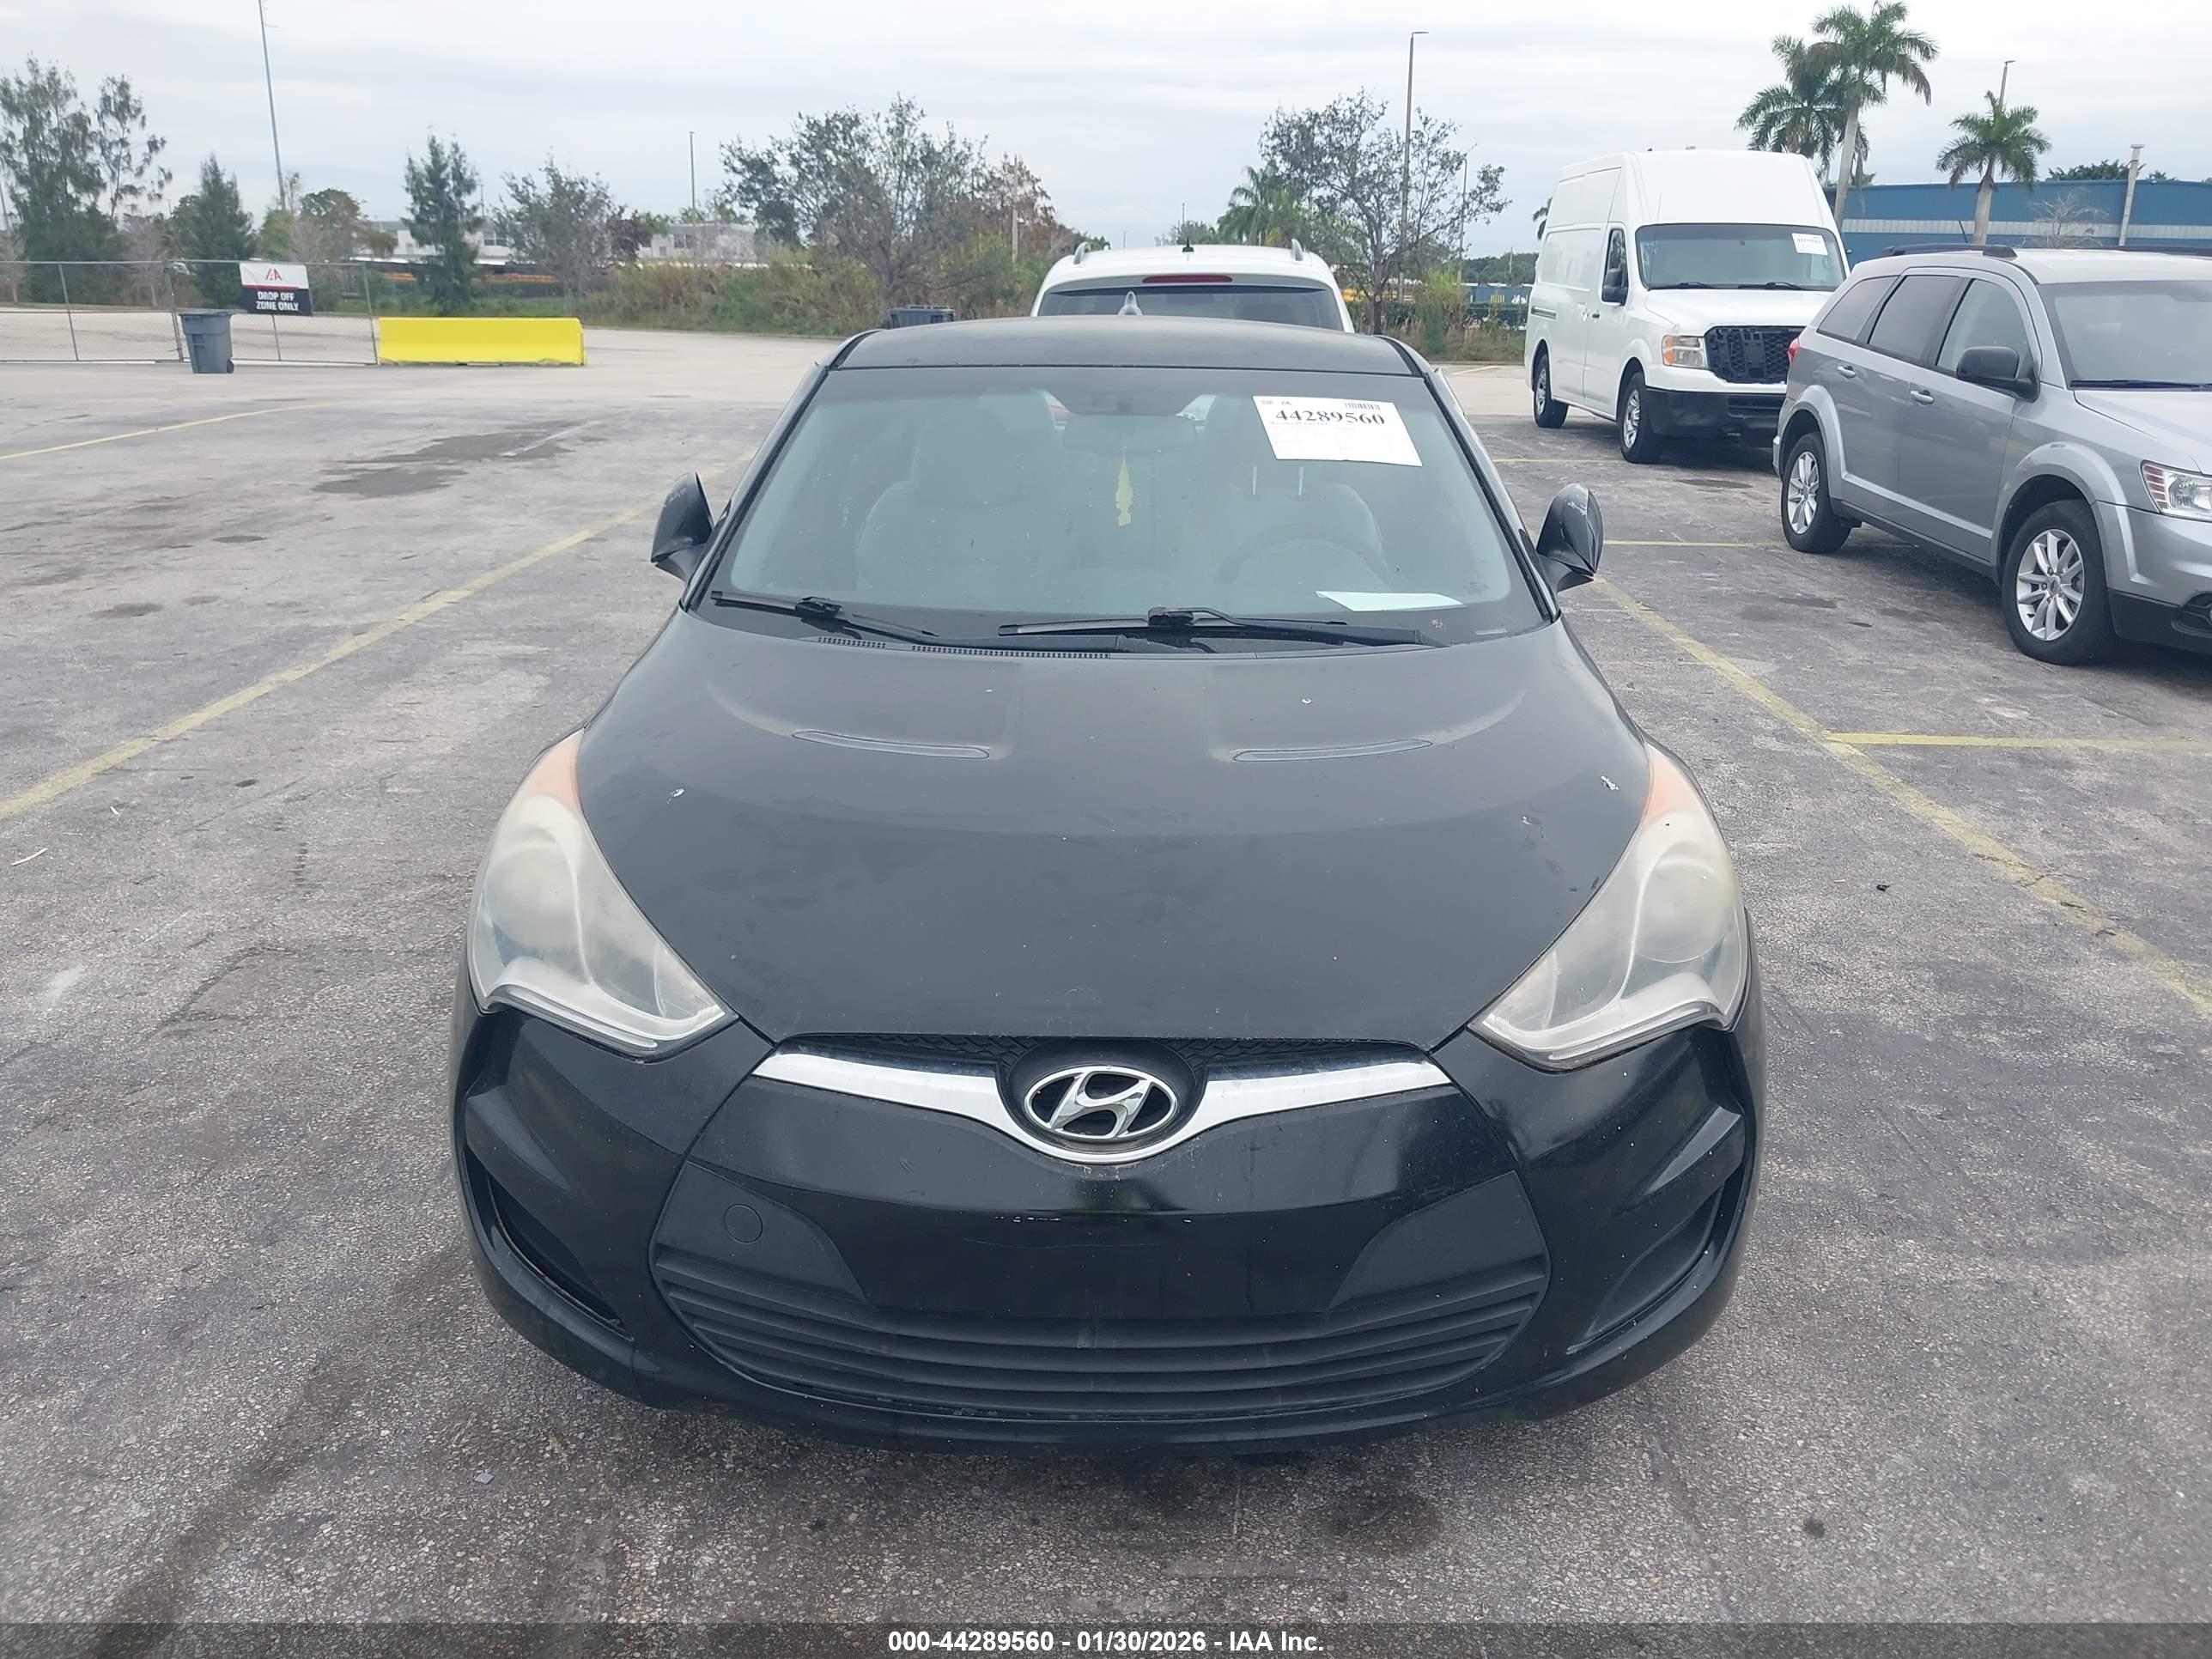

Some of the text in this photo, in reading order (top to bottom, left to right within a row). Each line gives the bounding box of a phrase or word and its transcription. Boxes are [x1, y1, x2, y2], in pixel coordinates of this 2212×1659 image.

[257, 290, 295, 301] DROP OFF
[256, 301, 300, 311] ZONE ONLY
[1275, 410, 1385, 425] 44289560
